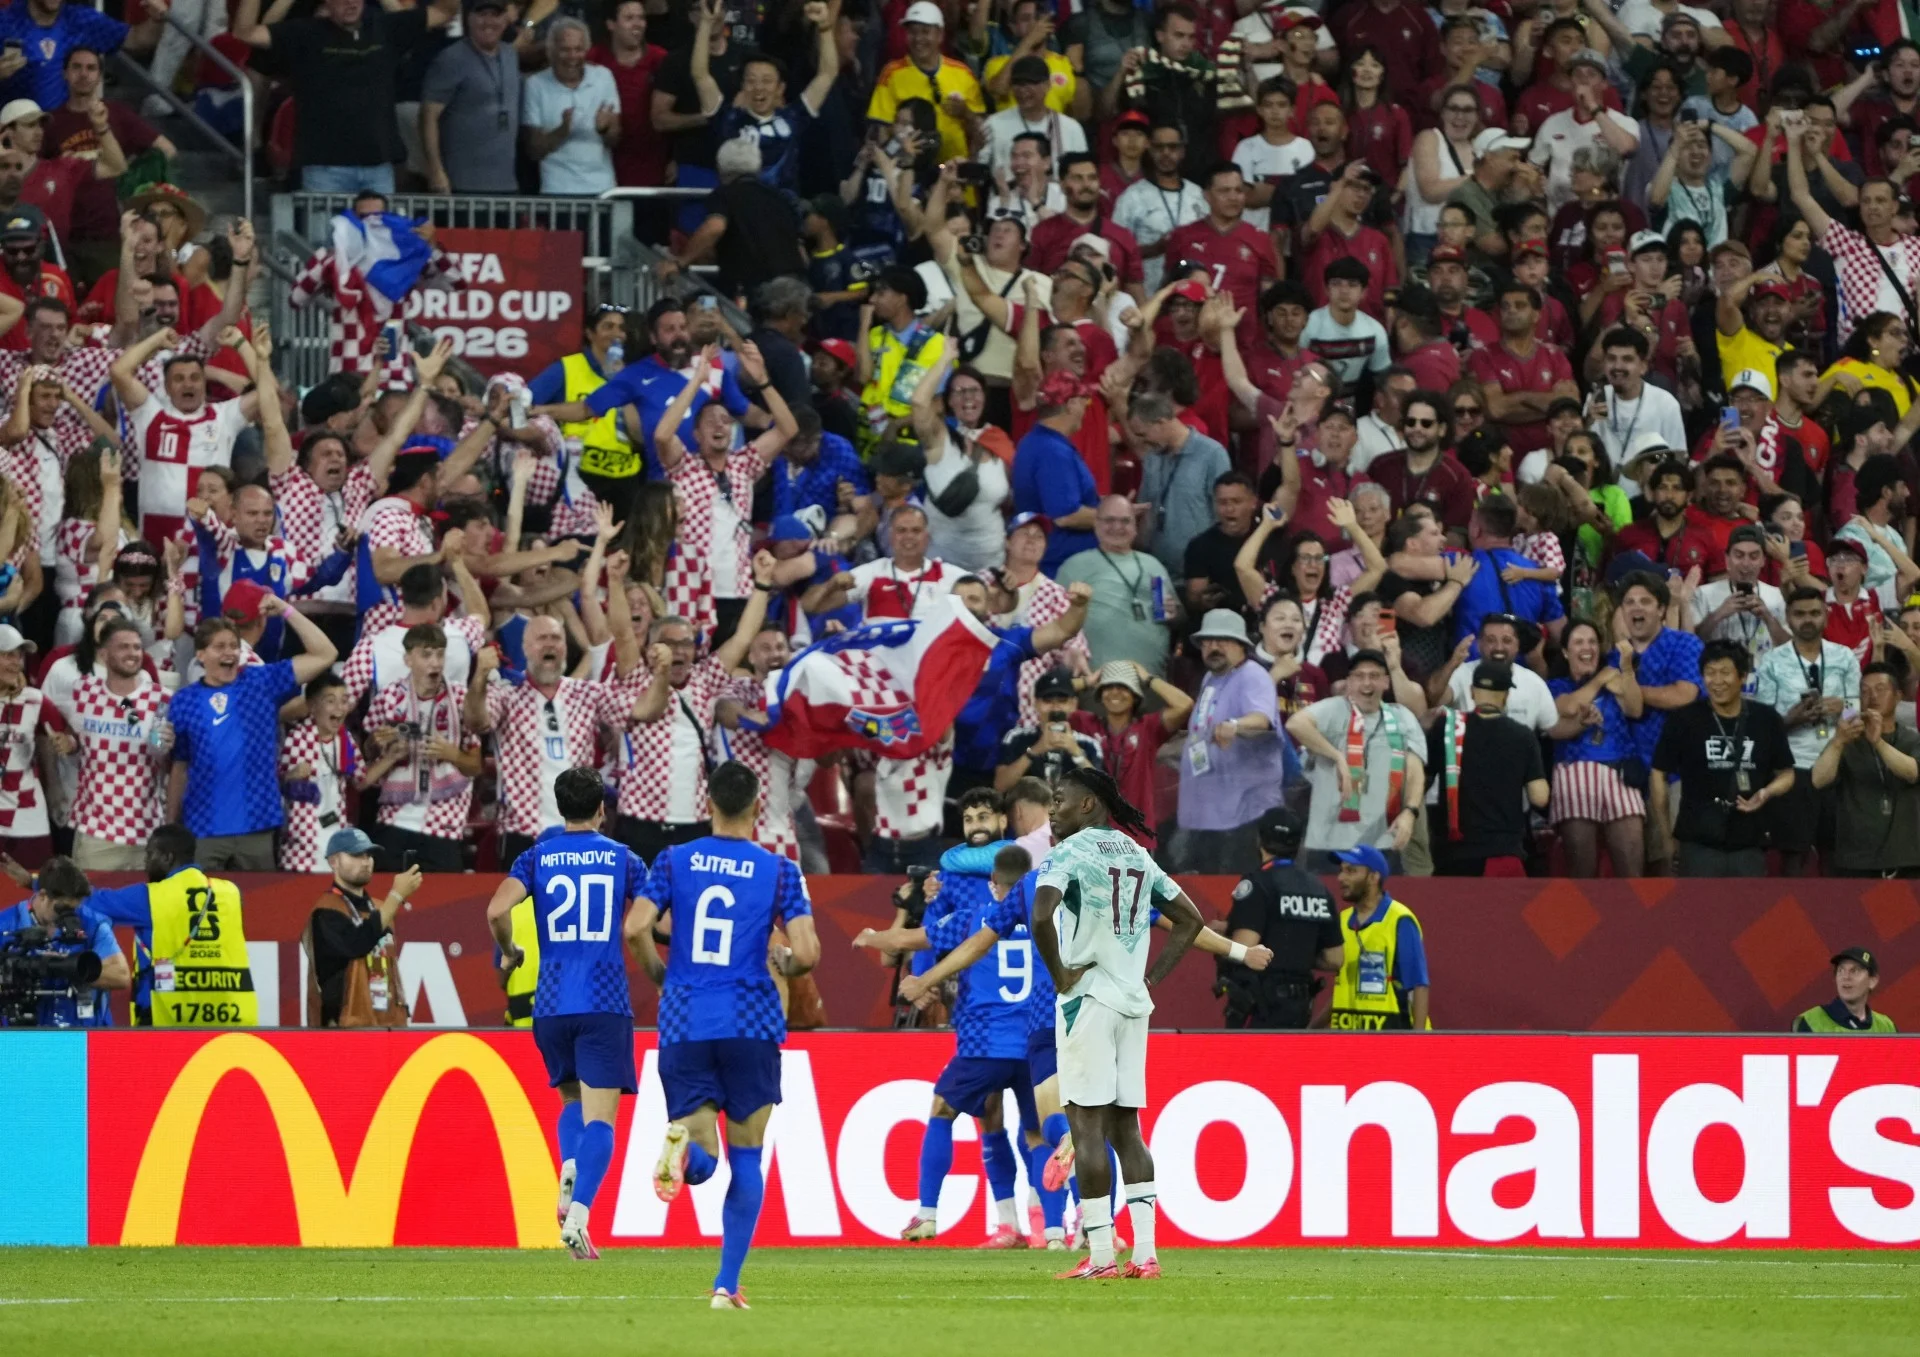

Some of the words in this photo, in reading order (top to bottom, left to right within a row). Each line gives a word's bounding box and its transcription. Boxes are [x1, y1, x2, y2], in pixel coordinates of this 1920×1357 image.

[404, 289, 494, 320] ORLD
[499, 290, 572, 321] CUP
[421, 326, 529, 358] 026
[157, 430, 179, 458] 10
[540, 850, 616, 867] MATANOVIĆ
[1096, 841, 1121, 855] RAFA
[545, 874, 614, 942] 20
[1107, 866, 1145, 935] 17
[1280, 895, 1331, 918] POLICE
[691, 884, 736, 967] 6
[189, 949, 221, 958] 2026
[175, 970, 242, 989] ECURITY
[997, 939, 1033, 1003] 9
[171, 1003, 241, 1023] 17862
